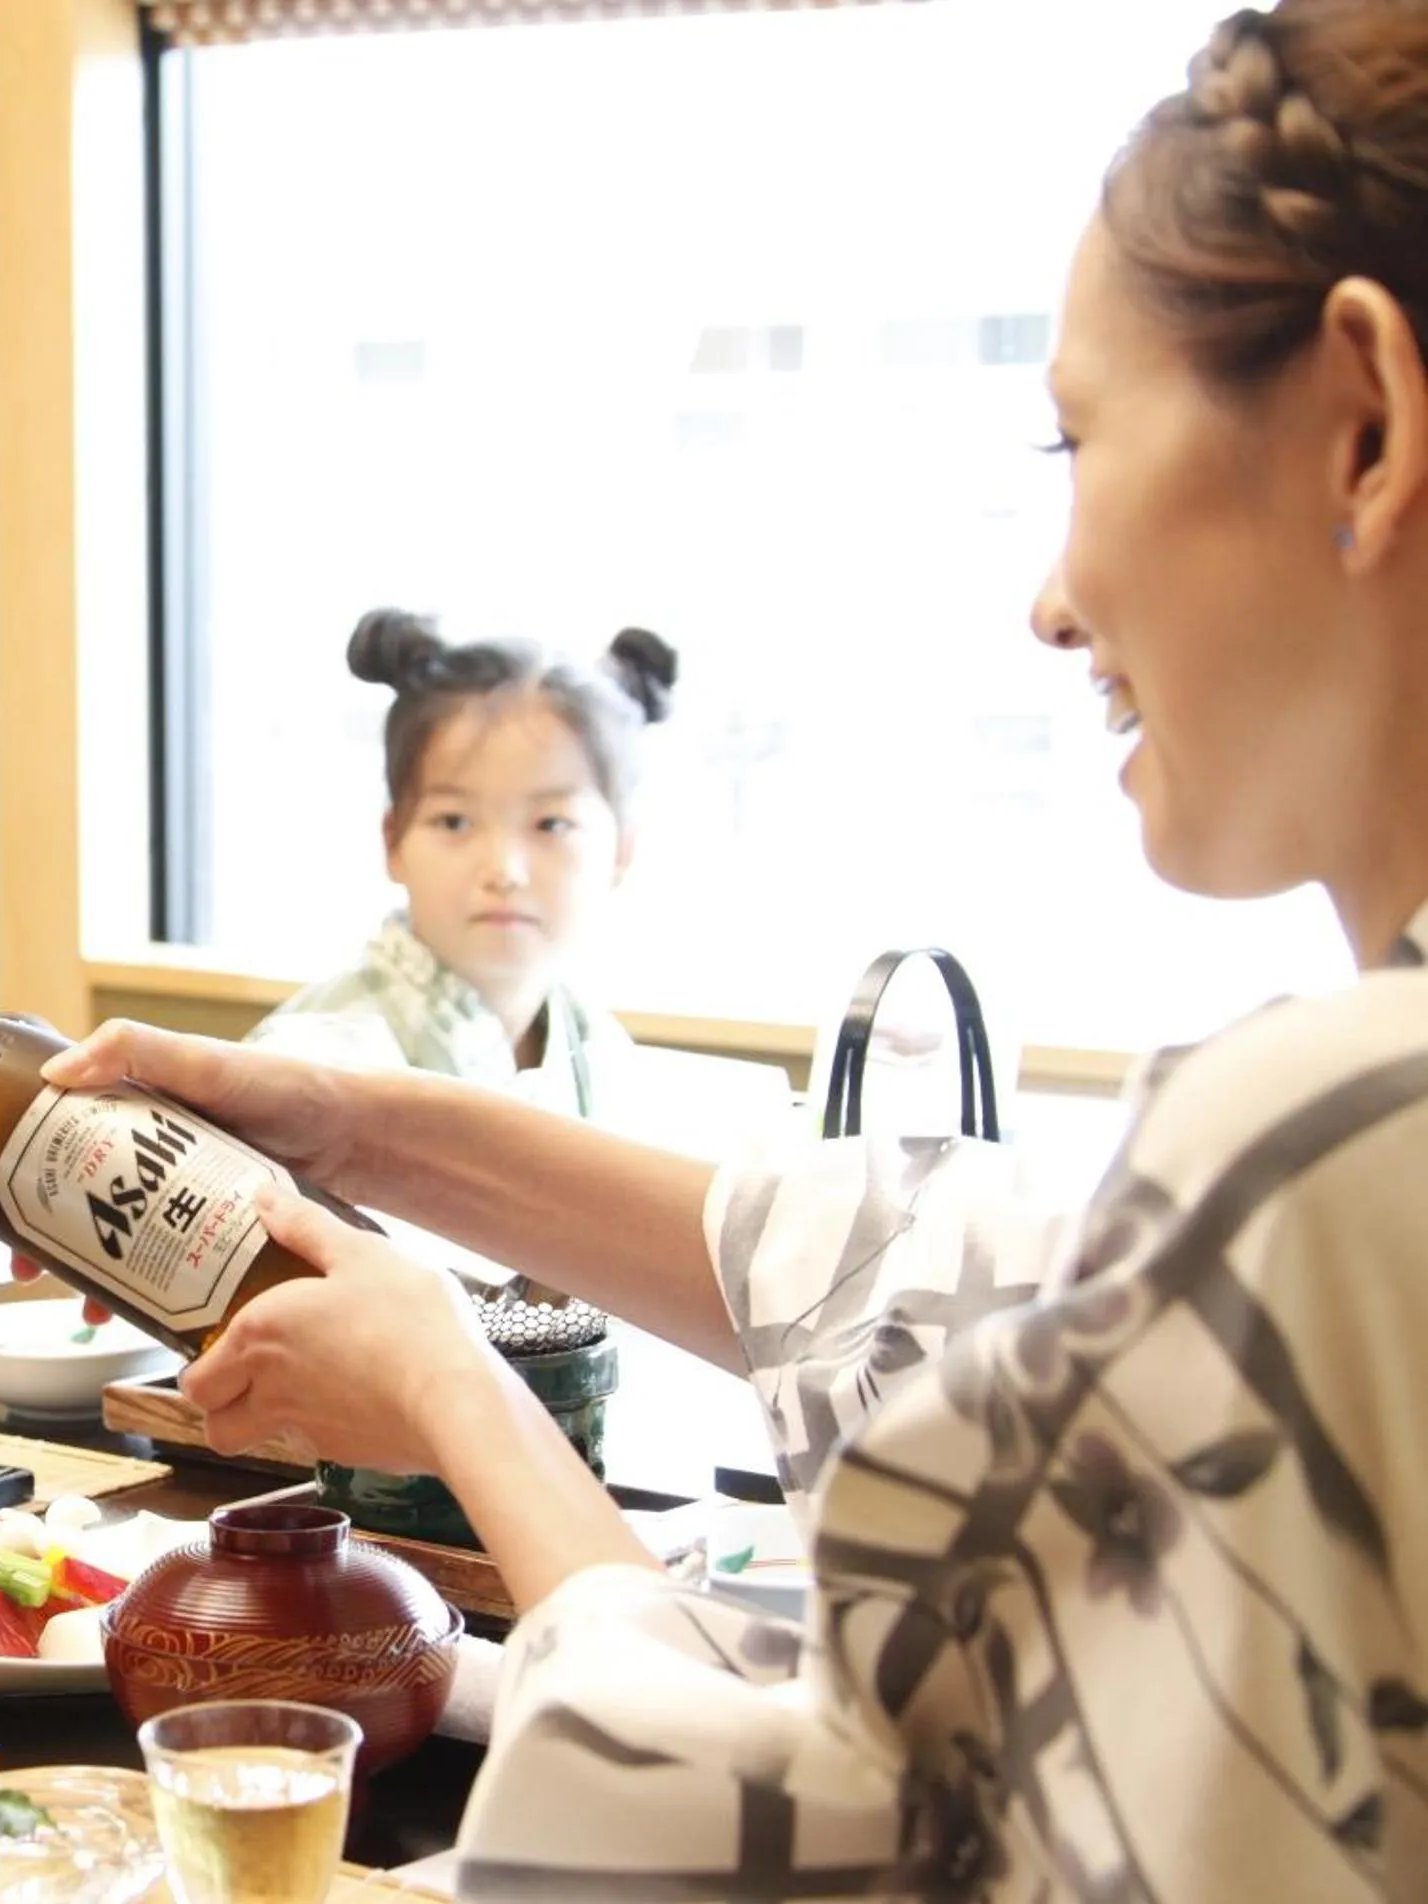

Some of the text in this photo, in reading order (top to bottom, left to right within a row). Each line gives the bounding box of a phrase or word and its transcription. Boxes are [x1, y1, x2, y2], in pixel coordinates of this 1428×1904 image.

[83, 1140, 114, 1179] DRY
[85, 1108, 198, 1261] Asahi
[162, 1187, 208, 1234] 生
[186, 1189, 243, 1270] スーパードライ
